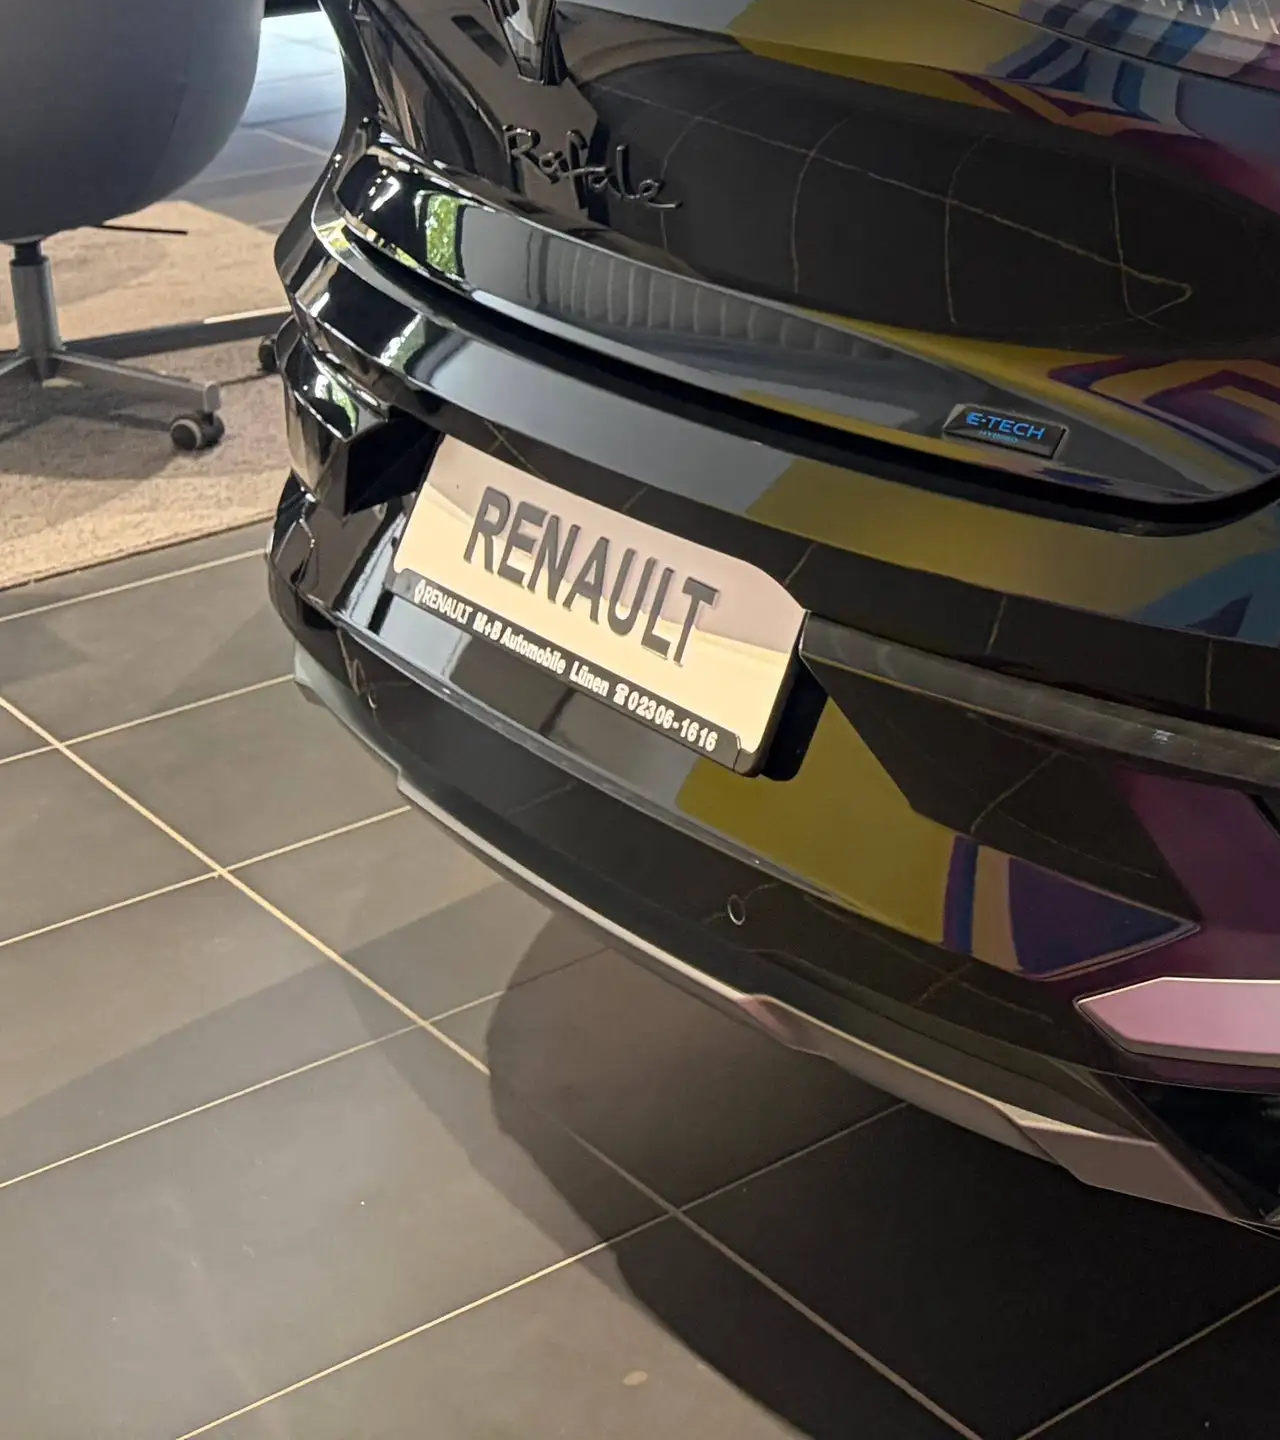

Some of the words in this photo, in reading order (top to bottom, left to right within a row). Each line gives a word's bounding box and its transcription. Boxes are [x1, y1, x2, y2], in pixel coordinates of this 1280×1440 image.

[966, 411, 1045, 440] E-TECH
[463, 486, 719, 667] RENAULT
[422, 588, 473, 625] RENAULT
[472, 611, 503, 641] M+B
[500, 627, 567, 675] Automobile
[569, 661, 610, 697] Lünen
[627, 691, 718, 752] 02306-1616
